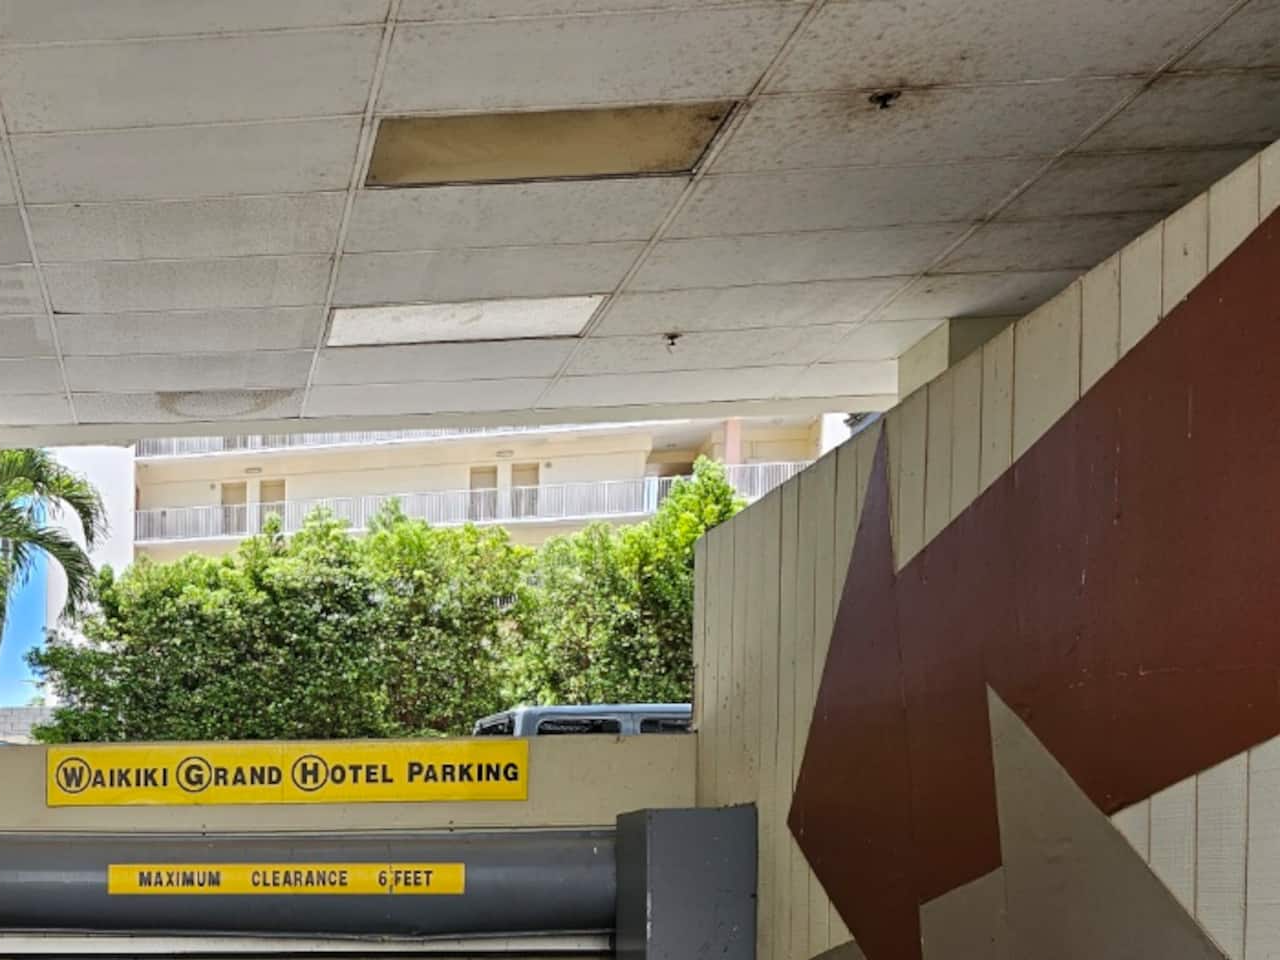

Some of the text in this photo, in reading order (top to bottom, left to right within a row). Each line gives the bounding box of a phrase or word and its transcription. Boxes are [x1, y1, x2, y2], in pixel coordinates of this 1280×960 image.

[138, 870, 221, 887] MAXIMUM
[251, 870, 348, 887] CLEARANCE
[393, 870, 433, 887] FEET
